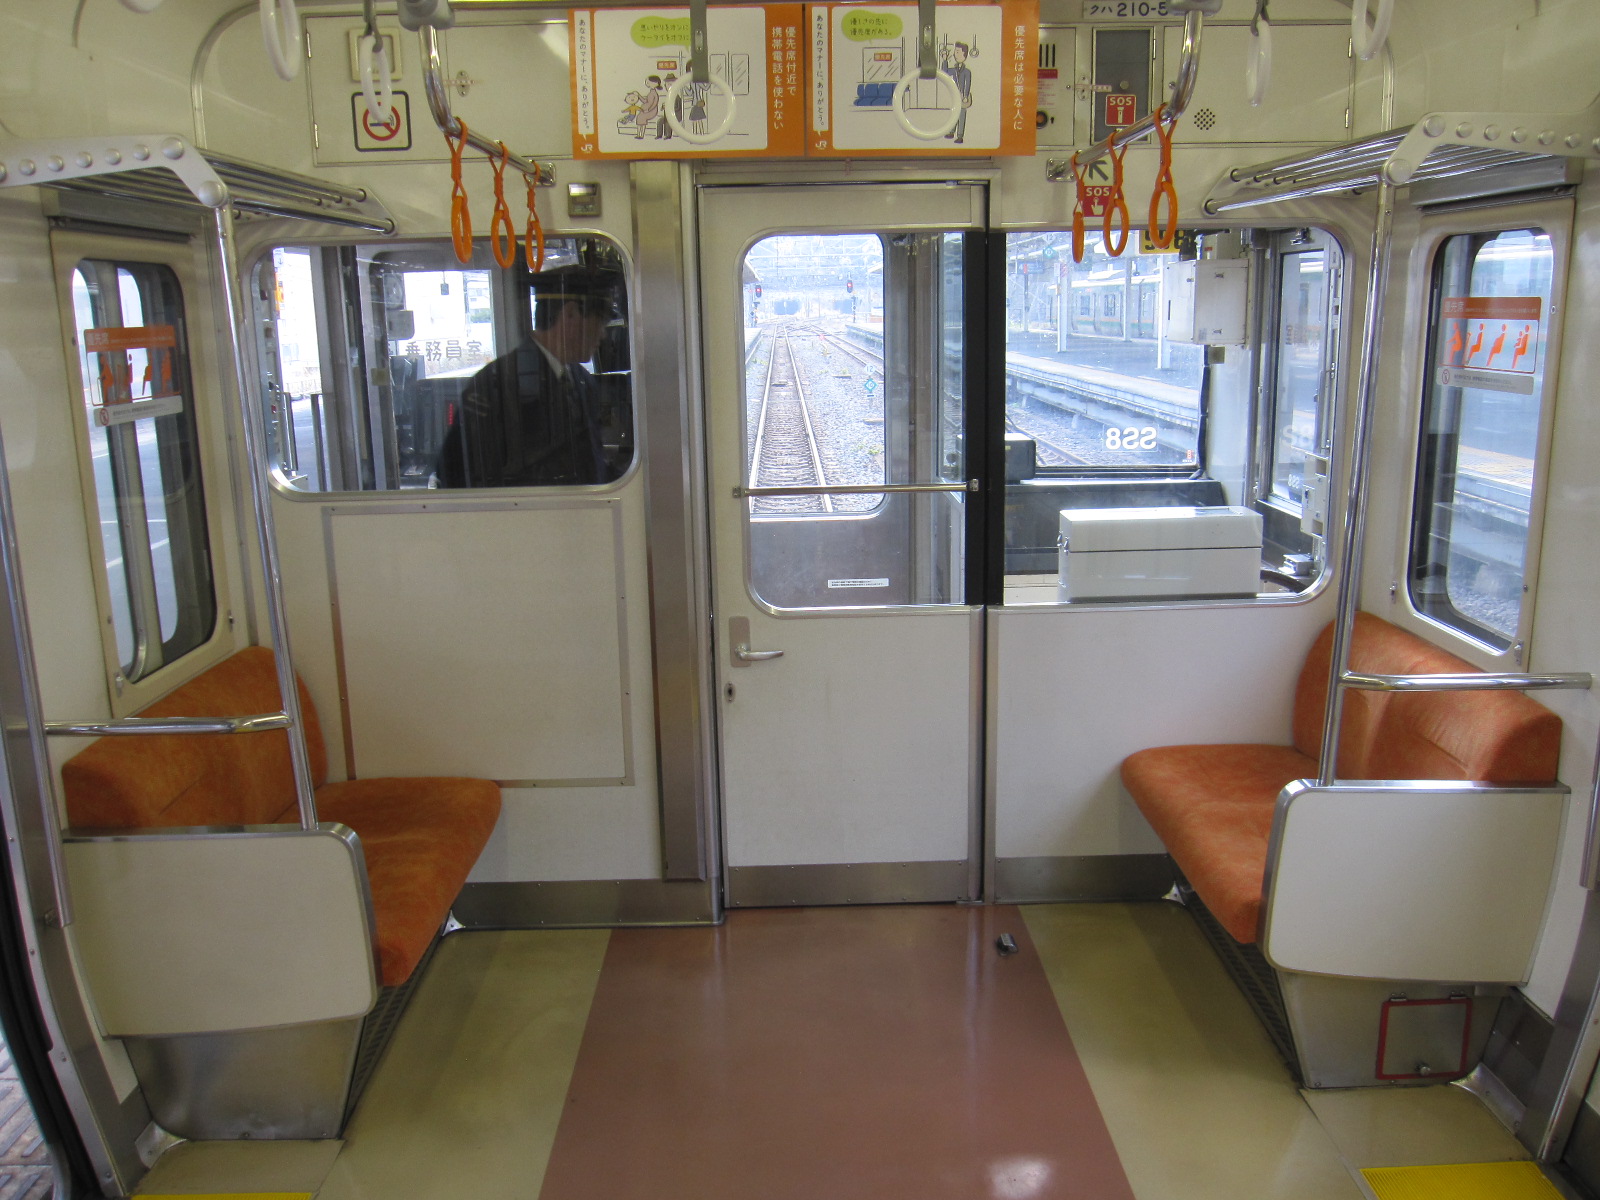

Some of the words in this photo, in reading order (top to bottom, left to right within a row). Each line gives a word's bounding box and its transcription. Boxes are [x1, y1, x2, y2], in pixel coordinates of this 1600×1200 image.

[772, 26, 784, 130] 携帯電話を使わない
[785, 26, 797, 96] 優先席付近で
[1013, 25, 1026, 130] 優先席は必要な人に
[1109, 97, 1132, 106] SOS
[815, 140, 827, 148] JR
[1086, 187, 1110, 197] SOS
